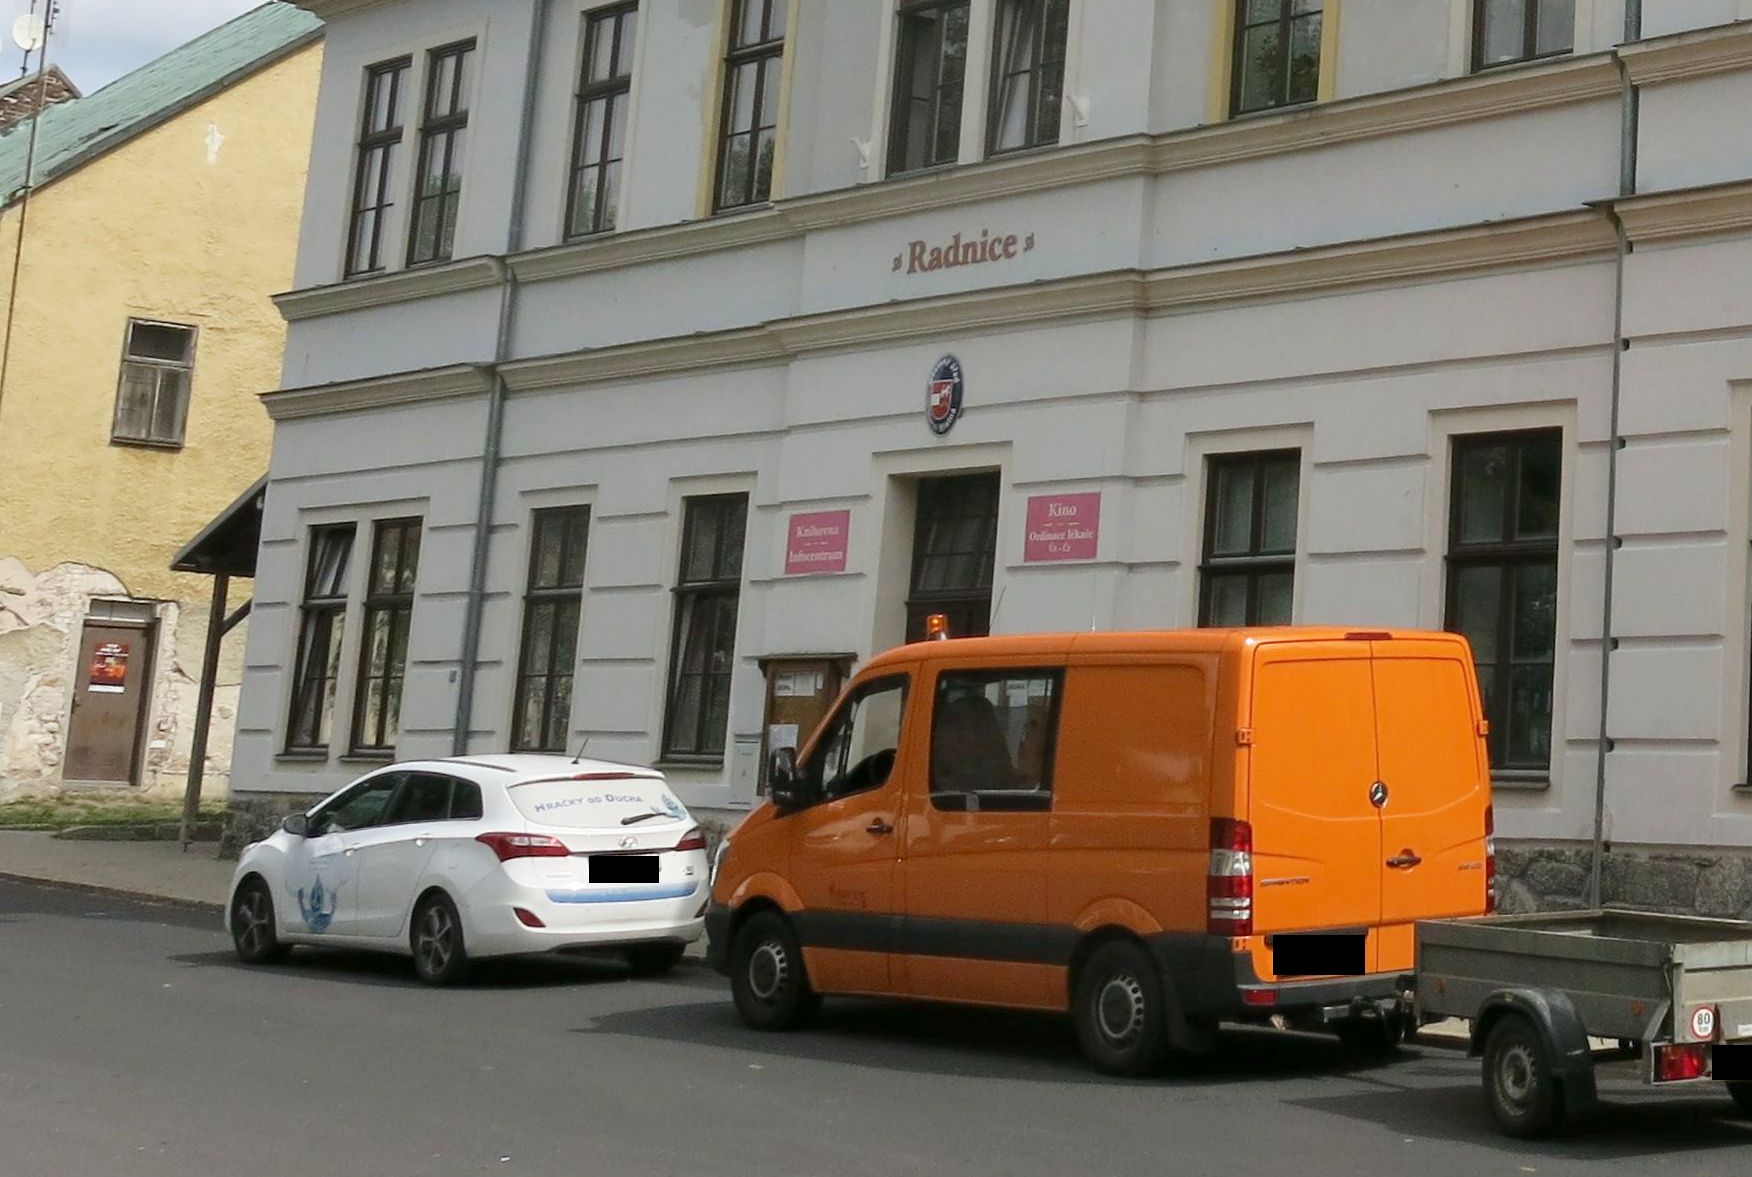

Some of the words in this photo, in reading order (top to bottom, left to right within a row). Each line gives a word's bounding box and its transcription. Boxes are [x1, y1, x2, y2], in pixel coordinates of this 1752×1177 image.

[906, 228, 1018, 275] Radnice
[1048, 503, 1077, 517] Kino
[1697, 1012, 1711, 1025] 80
